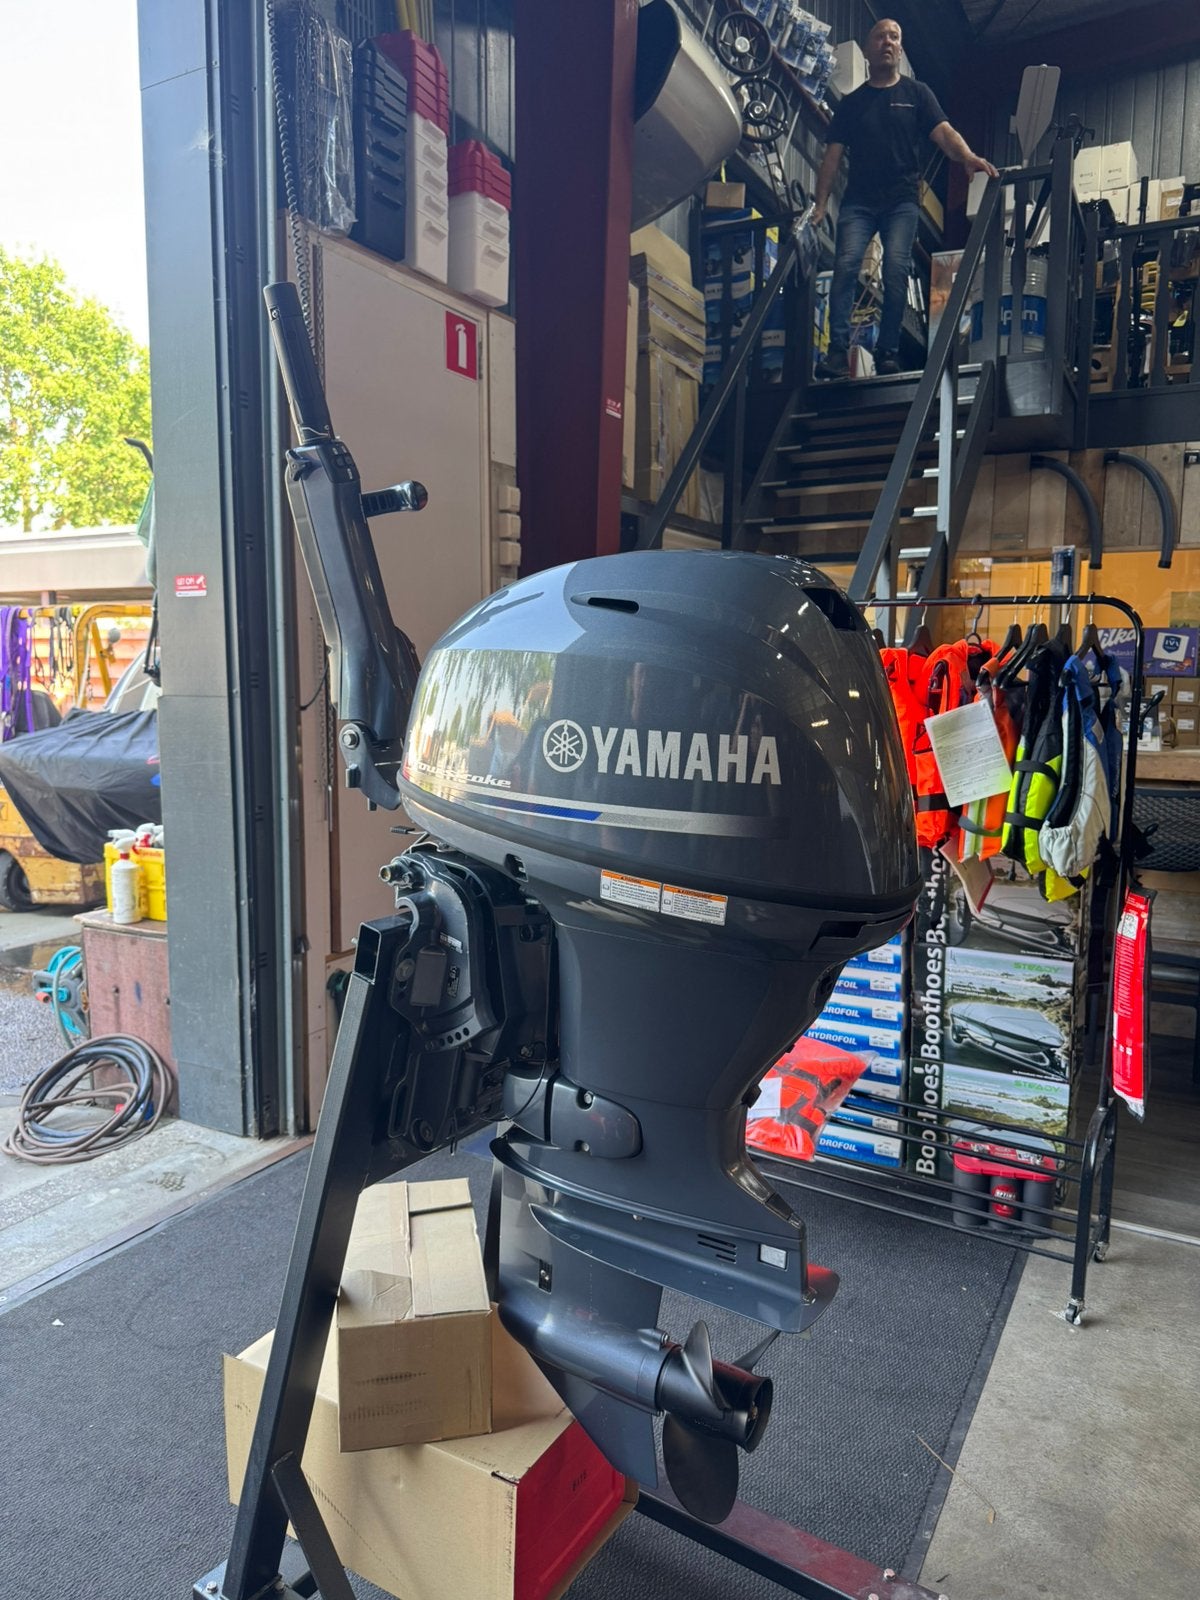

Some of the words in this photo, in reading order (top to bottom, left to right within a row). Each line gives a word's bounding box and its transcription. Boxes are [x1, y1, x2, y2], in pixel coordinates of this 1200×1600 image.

[592, 725, 782, 785] YAMAHA
[920, 947, 943, 1060] Boothoes
[807, 1030, 858, 1045] HYDROFOIL
